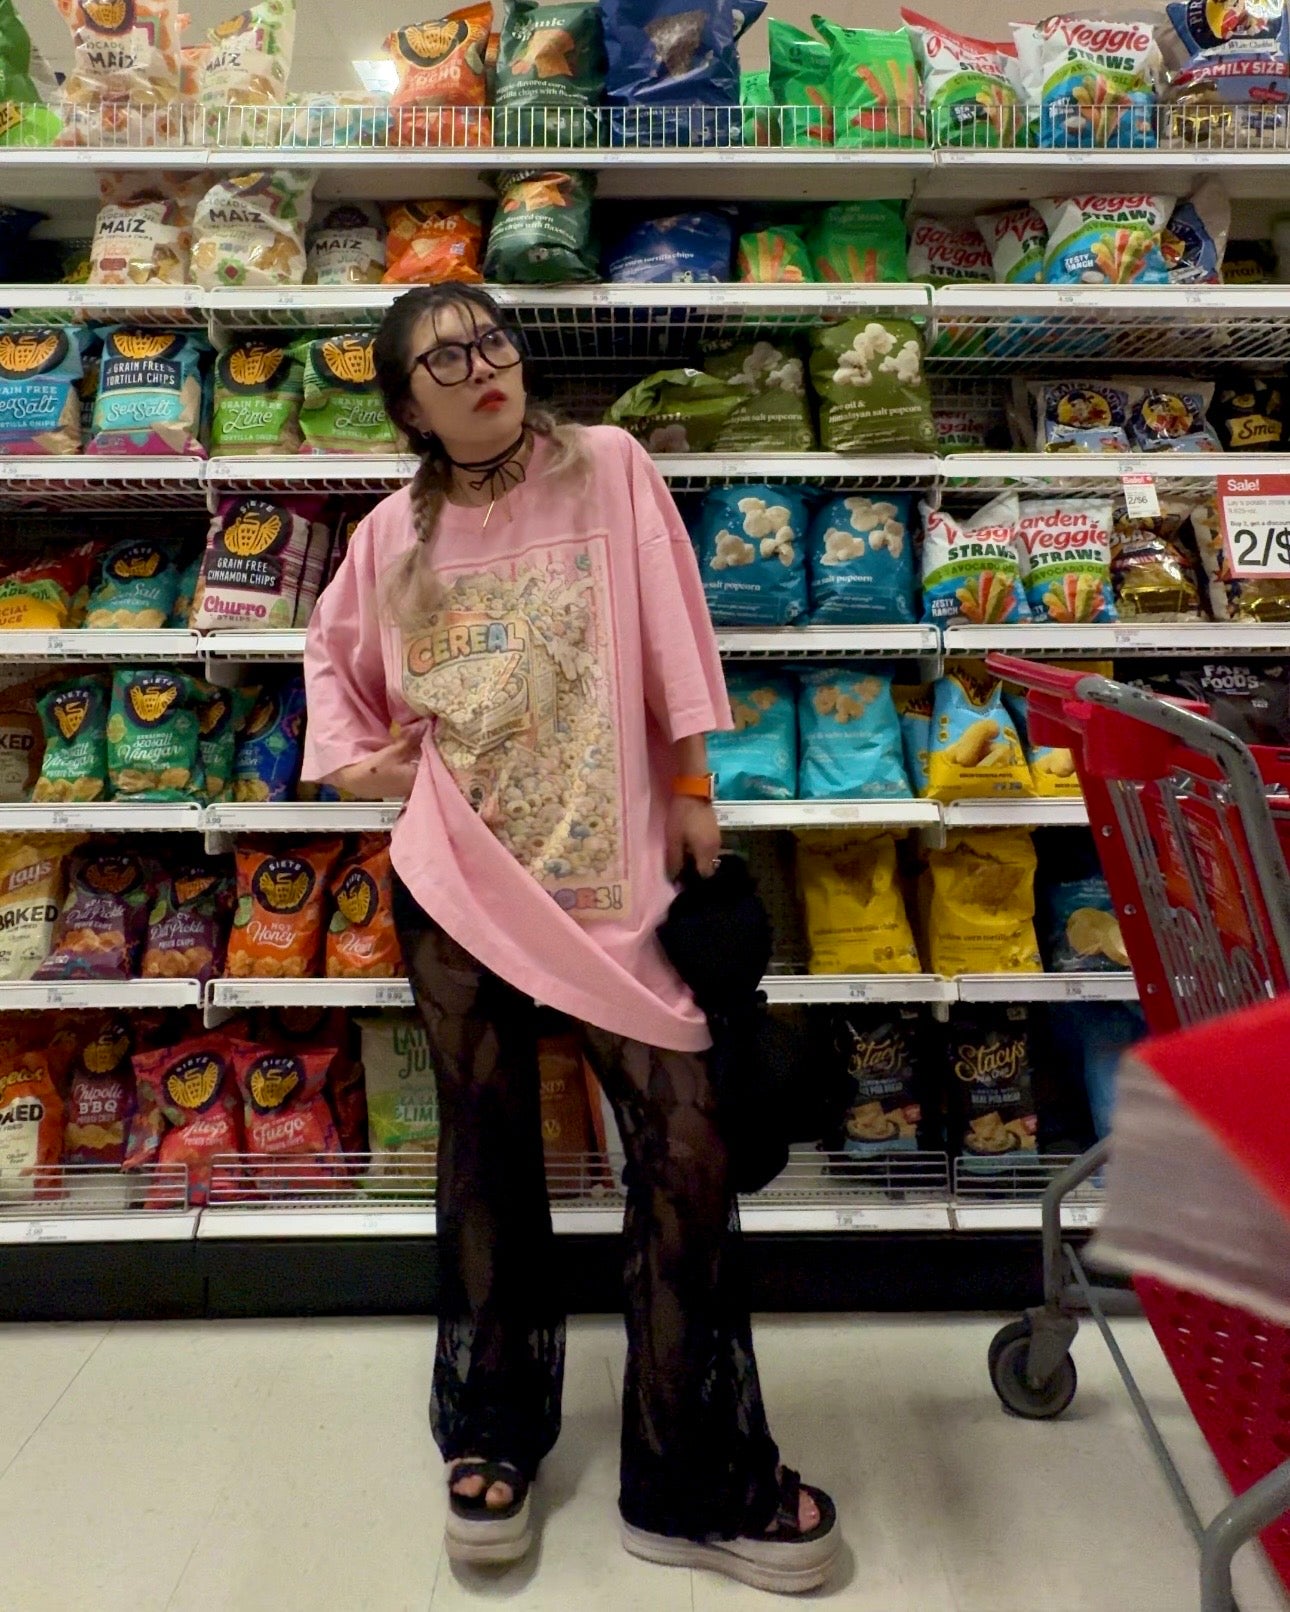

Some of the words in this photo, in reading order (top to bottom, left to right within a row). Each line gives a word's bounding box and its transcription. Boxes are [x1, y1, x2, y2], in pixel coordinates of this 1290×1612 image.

[1061, 24, 1150, 53] Veggie
[1068, 47, 1134, 71] STRAWS
[1193, 63, 1250, 80] FAMILY
[1252, 61, 1284, 74] SIZE
[1082, 209, 1157, 226] STRAWS
[672, 252, 694, 260] chips
[1064, 254, 1089, 264] ZESTY
[113, 361, 140, 373] GRAIN
[143, 360, 165, 372] FREE
[107, 373, 143, 386] TORTILLA
[147, 374, 175, 385] CHIPS
[26, 386, 58, 394] FREE
[335, 405, 386, 428] Lime
[767, 414, 803, 422] popcorn
[873, 406, 888, 417] salt
[889, 405, 922, 416] popcorn
[222, 406, 273, 434] Lime
[1226, 478, 1261, 492] Sale!
[240, 500, 275, 513] SIETE
[1127, 495, 1149, 505] 2/$6
[1020, 509, 1088, 530] arden
[1019, 523, 1109, 555] Veggie
[948, 543, 1017, 561] STRAWS
[1029, 548, 1104, 570] STRAWS
[217, 557, 243, 569] GRAIN
[245, 559, 268, 572] FREE
[207, 570, 247, 583] CINNAMON
[249, 573, 276, 587] CHIPS
[836, 574, 873, 584] popcorn
[724, 582, 761, 592] popcorn
[203, 595, 267, 618] Churro
[931, 598, 954, 608] ZESTY
[931, 607, 959, 617] RANCH
[0, 615, 22, 625] UCE
[407, 622, 526, 677] CEREAL
[142, 677, 174, 687] SIETE
[1200, 674, 1259, 688] FOODS
[117, 744, 182, 765] Vinegar
[269, 861, 301, 871] SIETE
[246, 920, 296, 949] Honey
[954, 1040, 1026, 1082] Stacy's
[73, 1083, 124, 1103] Chipotle
[79, 1099, 118, 1115] BBQ
[253, 1117, 305, 1148] Fuego
